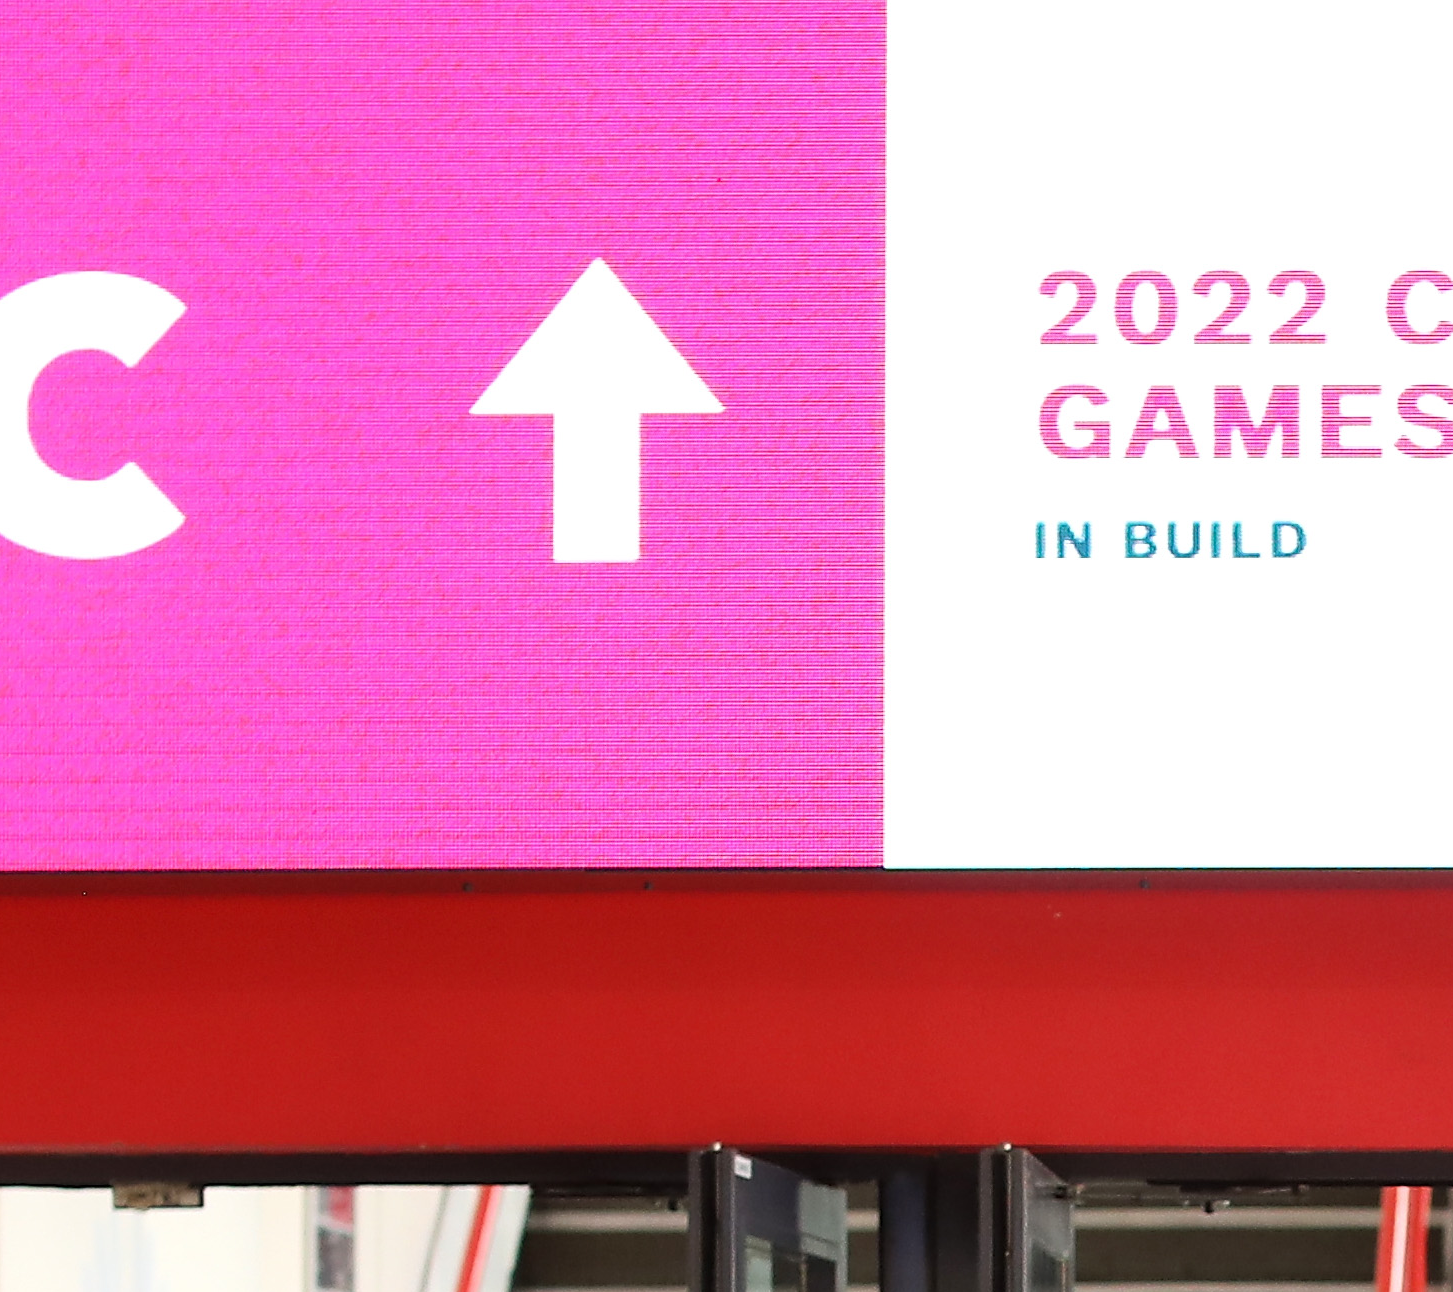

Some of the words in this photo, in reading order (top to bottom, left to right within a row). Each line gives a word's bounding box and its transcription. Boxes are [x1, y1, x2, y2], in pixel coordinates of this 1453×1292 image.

[1038, 269, 1327, 346] 2022
[1035, 520, 1093, 559] IN
[1124, 520, 1308, 559] BUILD
